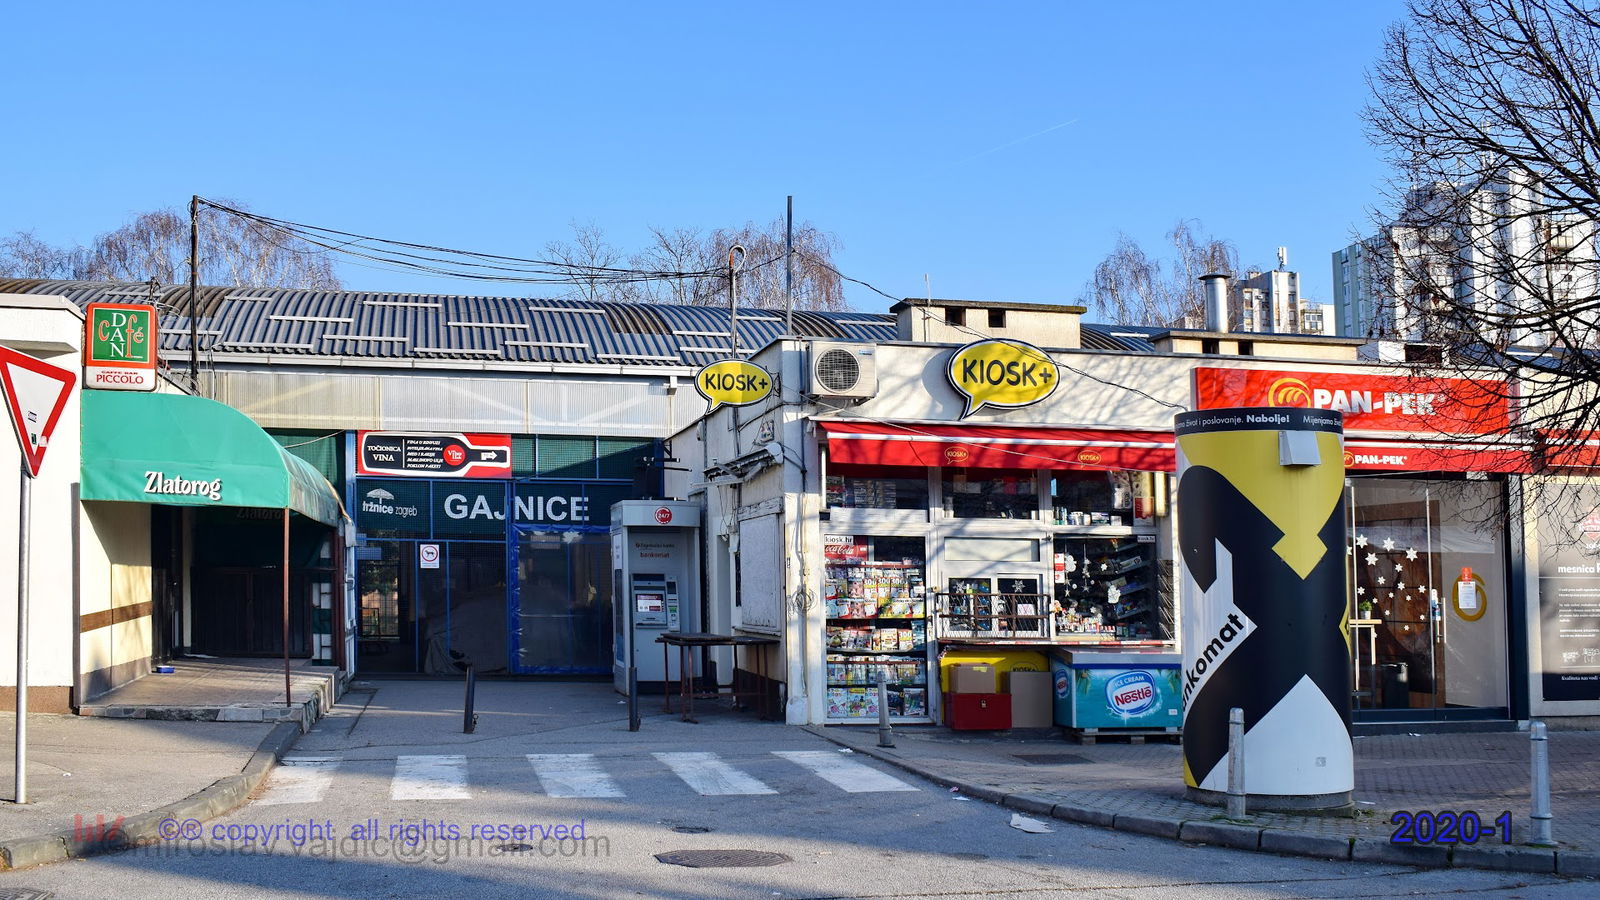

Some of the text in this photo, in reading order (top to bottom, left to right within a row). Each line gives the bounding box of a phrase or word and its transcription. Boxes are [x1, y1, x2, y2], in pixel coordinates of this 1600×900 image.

[110, 312, 126, 358] DAN
[96, 374, 144, 385] PICCOLO
[963, 358, 1052, 387] KIOSK+
[705, 373, 768, 391] KIOSK+
[1313, 388, 1436, 416] PAN-PEK
[1202, 415, 1244, 427] poslovanje.
[1246, 414, 1290, 425] Nabolje!
[1303, 415, 1334, 427] Mijenjamo
[373, 454, 395, 462] VINA
[1354, 454, 1404, 465] PAN-PEK
[144, 471, 222, 500] Zlatorog
[362, 500, 418, 518] tržnice zagreb
[443, 493, 590, 522] GAJNICE
[1557, 564, 1595, 573] mesnica
[1124, 676, 1145, 685] CREAM
[1115, 686, 1152, 706] Nestlé
